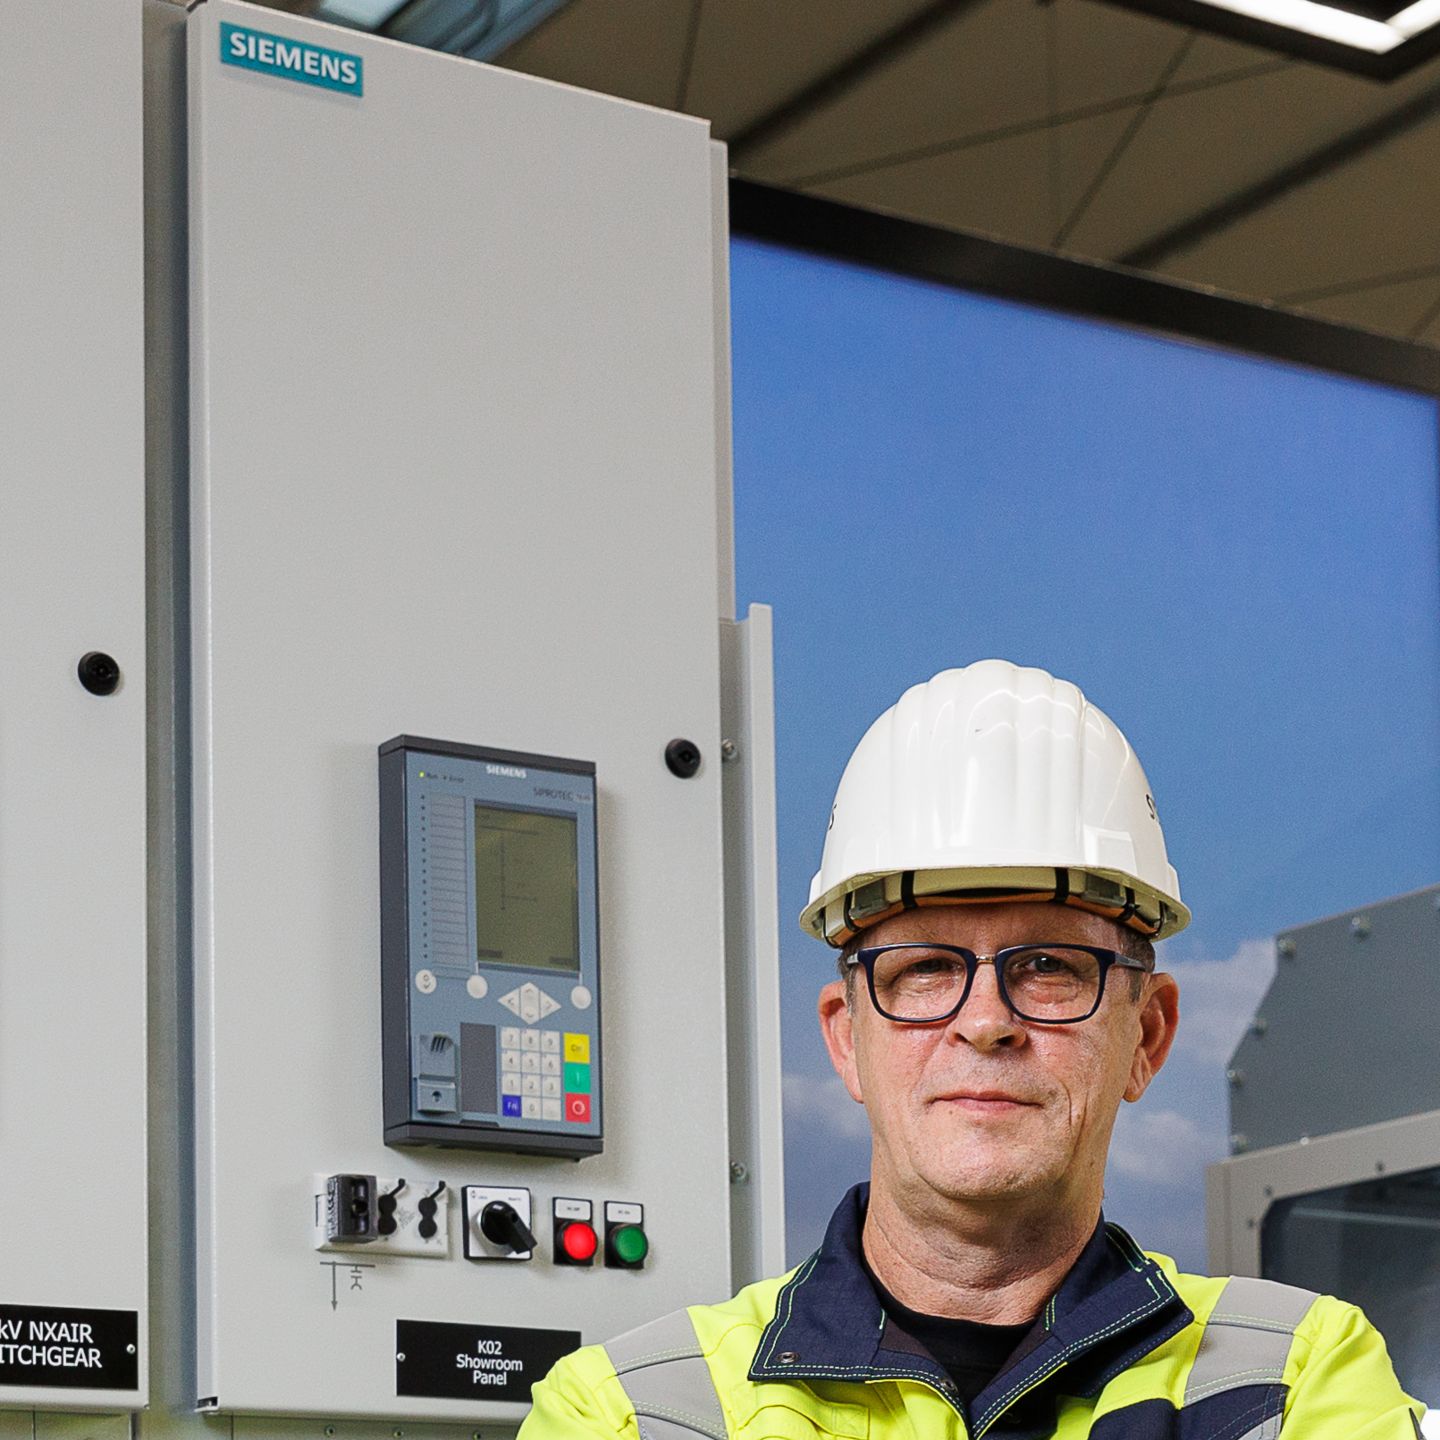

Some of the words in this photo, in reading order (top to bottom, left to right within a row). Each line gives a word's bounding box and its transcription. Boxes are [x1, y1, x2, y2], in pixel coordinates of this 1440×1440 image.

[229, 32, 357, 84] SIEMENS
[485, 764, 527, 778] SIEMENS
[28, 1320, 94, 1345] NXAIR
[478, 1340, 502, 1355] K02
[456, 1353, 523, 1372] Showroom
[473, 1370, 507, 1385] Panel
